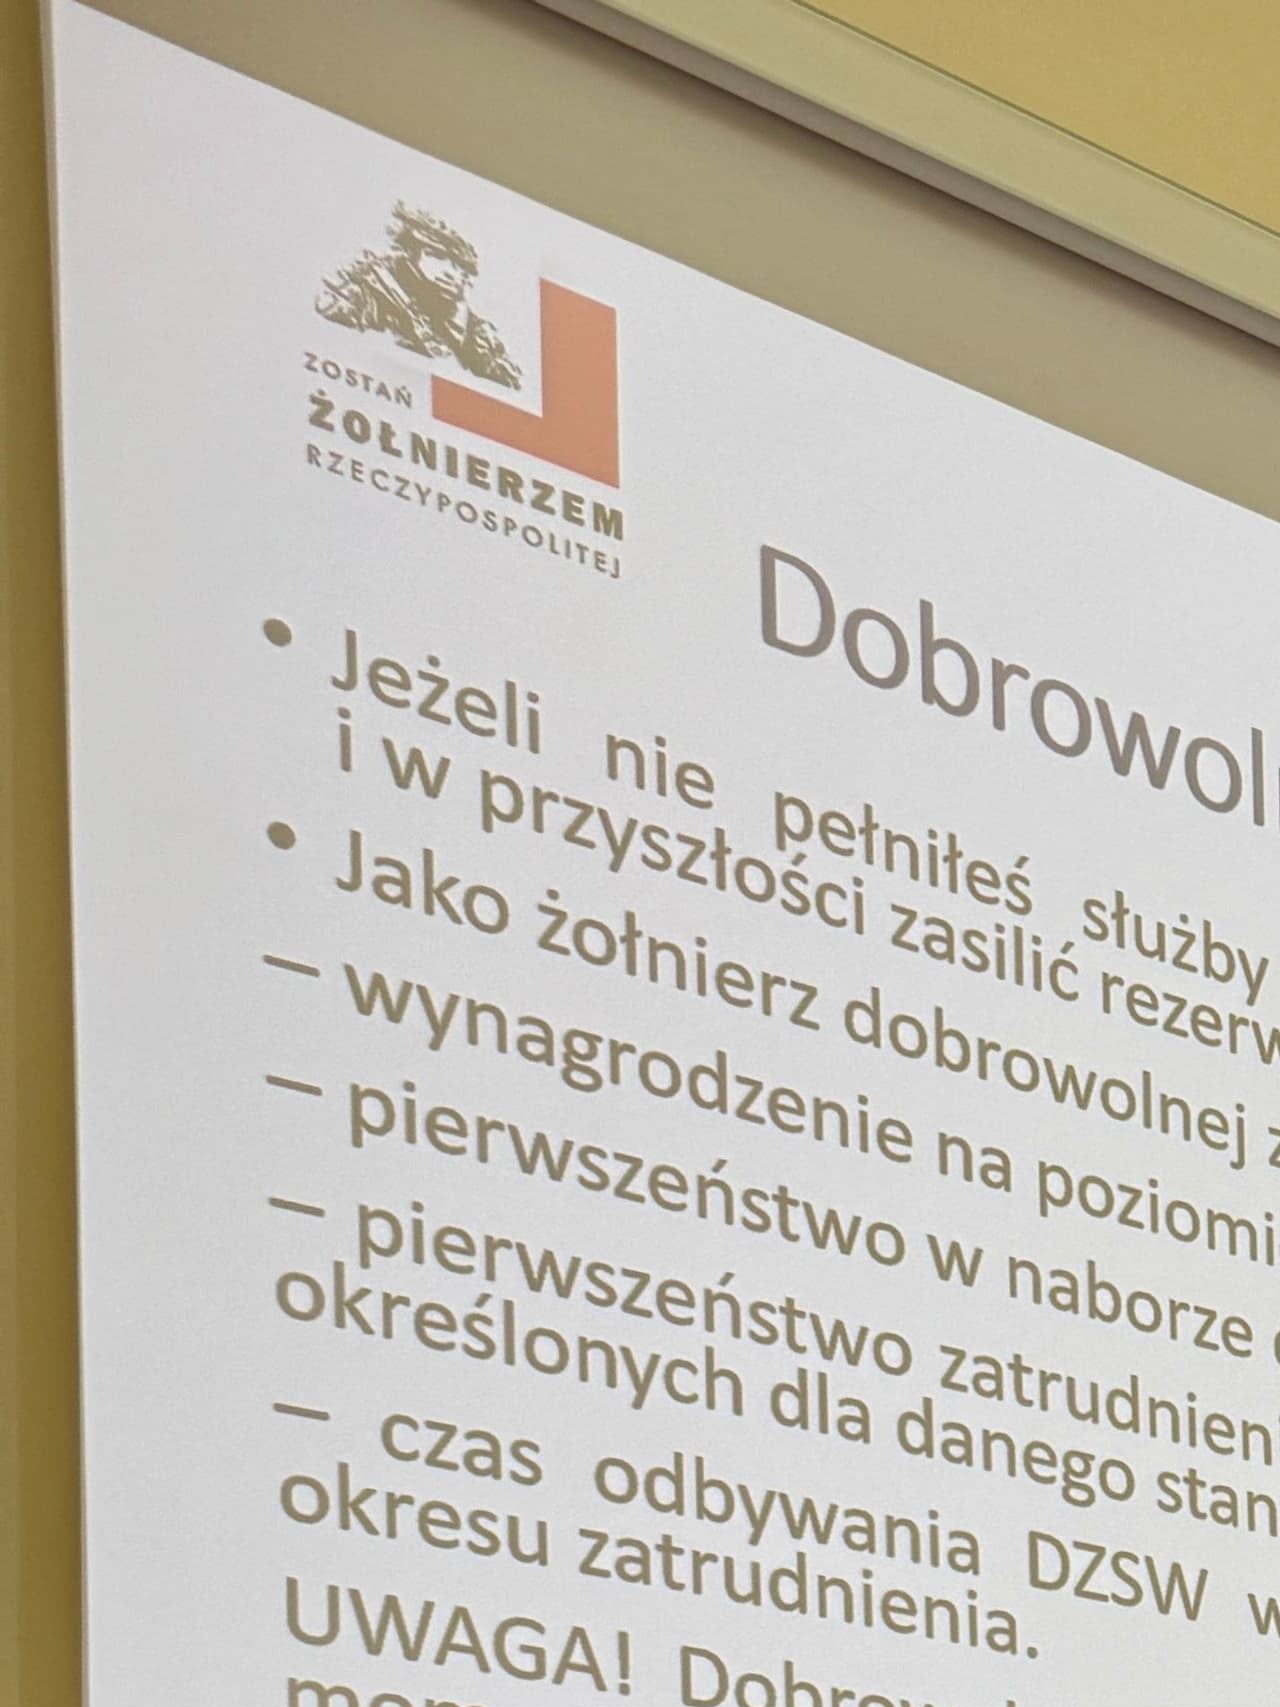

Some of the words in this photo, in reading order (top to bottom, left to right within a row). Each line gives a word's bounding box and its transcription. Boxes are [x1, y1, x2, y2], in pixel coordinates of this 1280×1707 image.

[303, 352, 413, 409] ZOSTAŃ
[308, 389, 624, 541] ŻOŁNIERZEM
[306, 443, 621, 580] RZECZYPOSPOLITEJ
[330, 628, 541, 755] Jeżeli
[605, 733, 715, 810] nie
[774, 791, 1033, 917] pełniłeś
[1082, 889, 1270, 1008] służby
[336, 706, 353, 773] i
[381, 735, 451, 800] w
[479, 768, 865, 936] przyszłości
[890, 903, 1080, 1002] zasilić
[335, 829, 510, 935] Jako
[536, 888, 821, 1032] żołnierz
[843, 985, 1246, 1171] dobrowolnej
[342, 962, 913, 1164] wynagrodzenie
[937, 1131, 1012, 1193] na
[349, 1080, 906, 1267] pierwszeństwo
[925, 1233, 985, 1288] w
[1008, 1255, 1254, 1359] naborze
[357, 1200, 913, 1377] pierwszeństwo
[275, 1259, 744, 1417] określonych
[769, 1366, 871, 1445] dla
[896, 1396, 1136, 1509] danego
[279, 1461, 549, 1568] okresu
[578, 1527, 1039, 1660] zatrudnienia.
[380, 1413, 543, 1487] czas
[593, 1450, 981, 1577] odbywania
[1027, 1529, 1209, 1622] DZSW
[285, 1575, 631, 1697] UWAGA!
